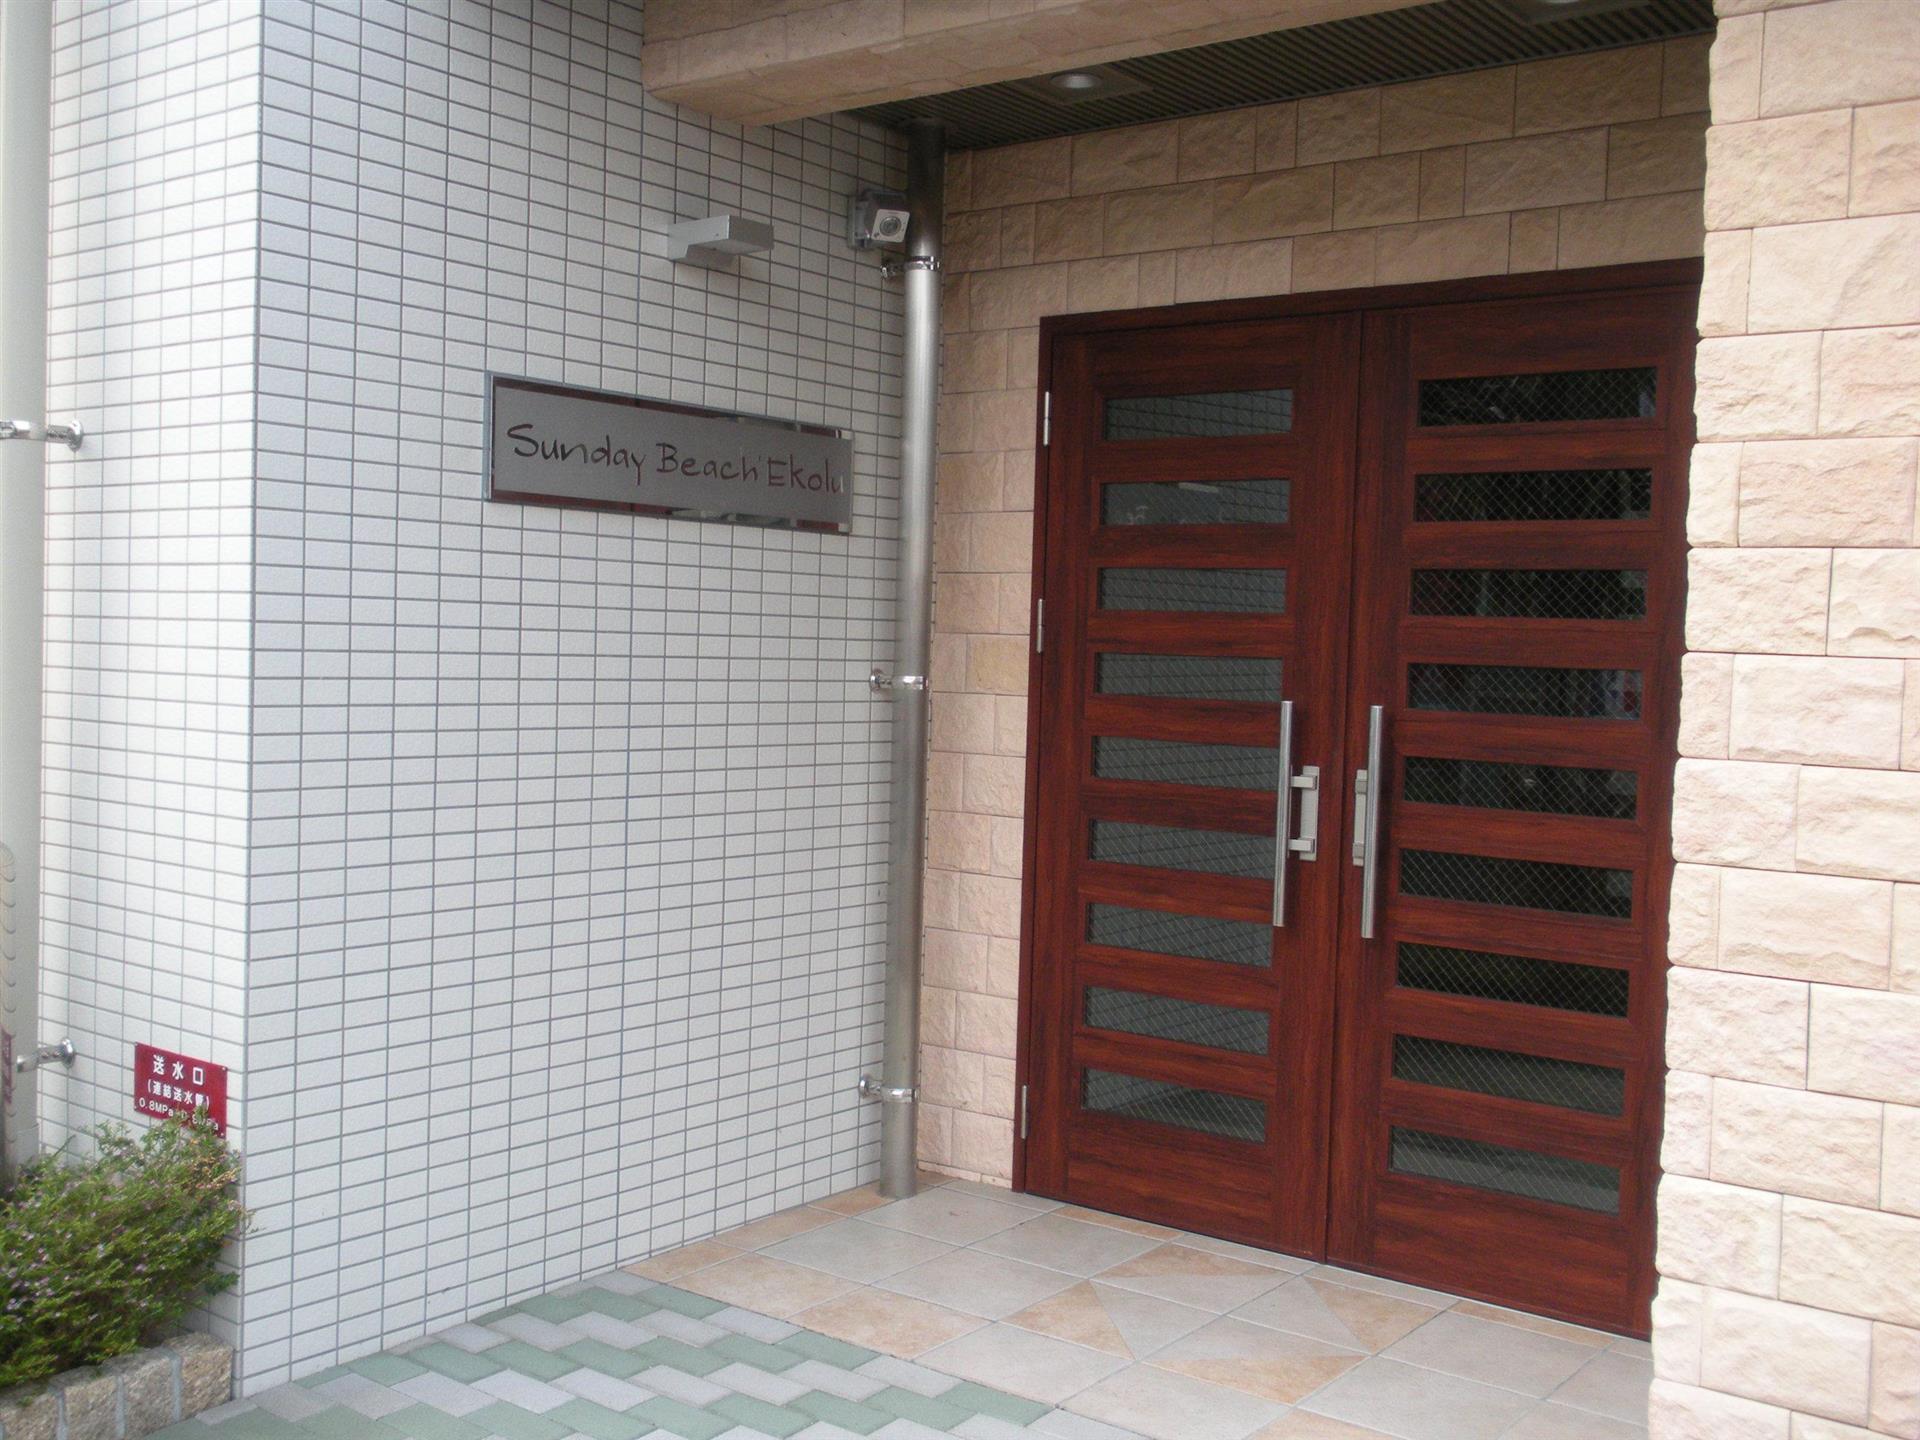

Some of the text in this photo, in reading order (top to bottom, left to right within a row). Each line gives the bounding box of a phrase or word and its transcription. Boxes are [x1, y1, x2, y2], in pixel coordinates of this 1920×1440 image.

[506, 423, 844, 494] Sunday Beach Ekolu
[153, 1054, 204, 1085] 送水口
[139, 1097, 174, 1117] 0.8MPa
